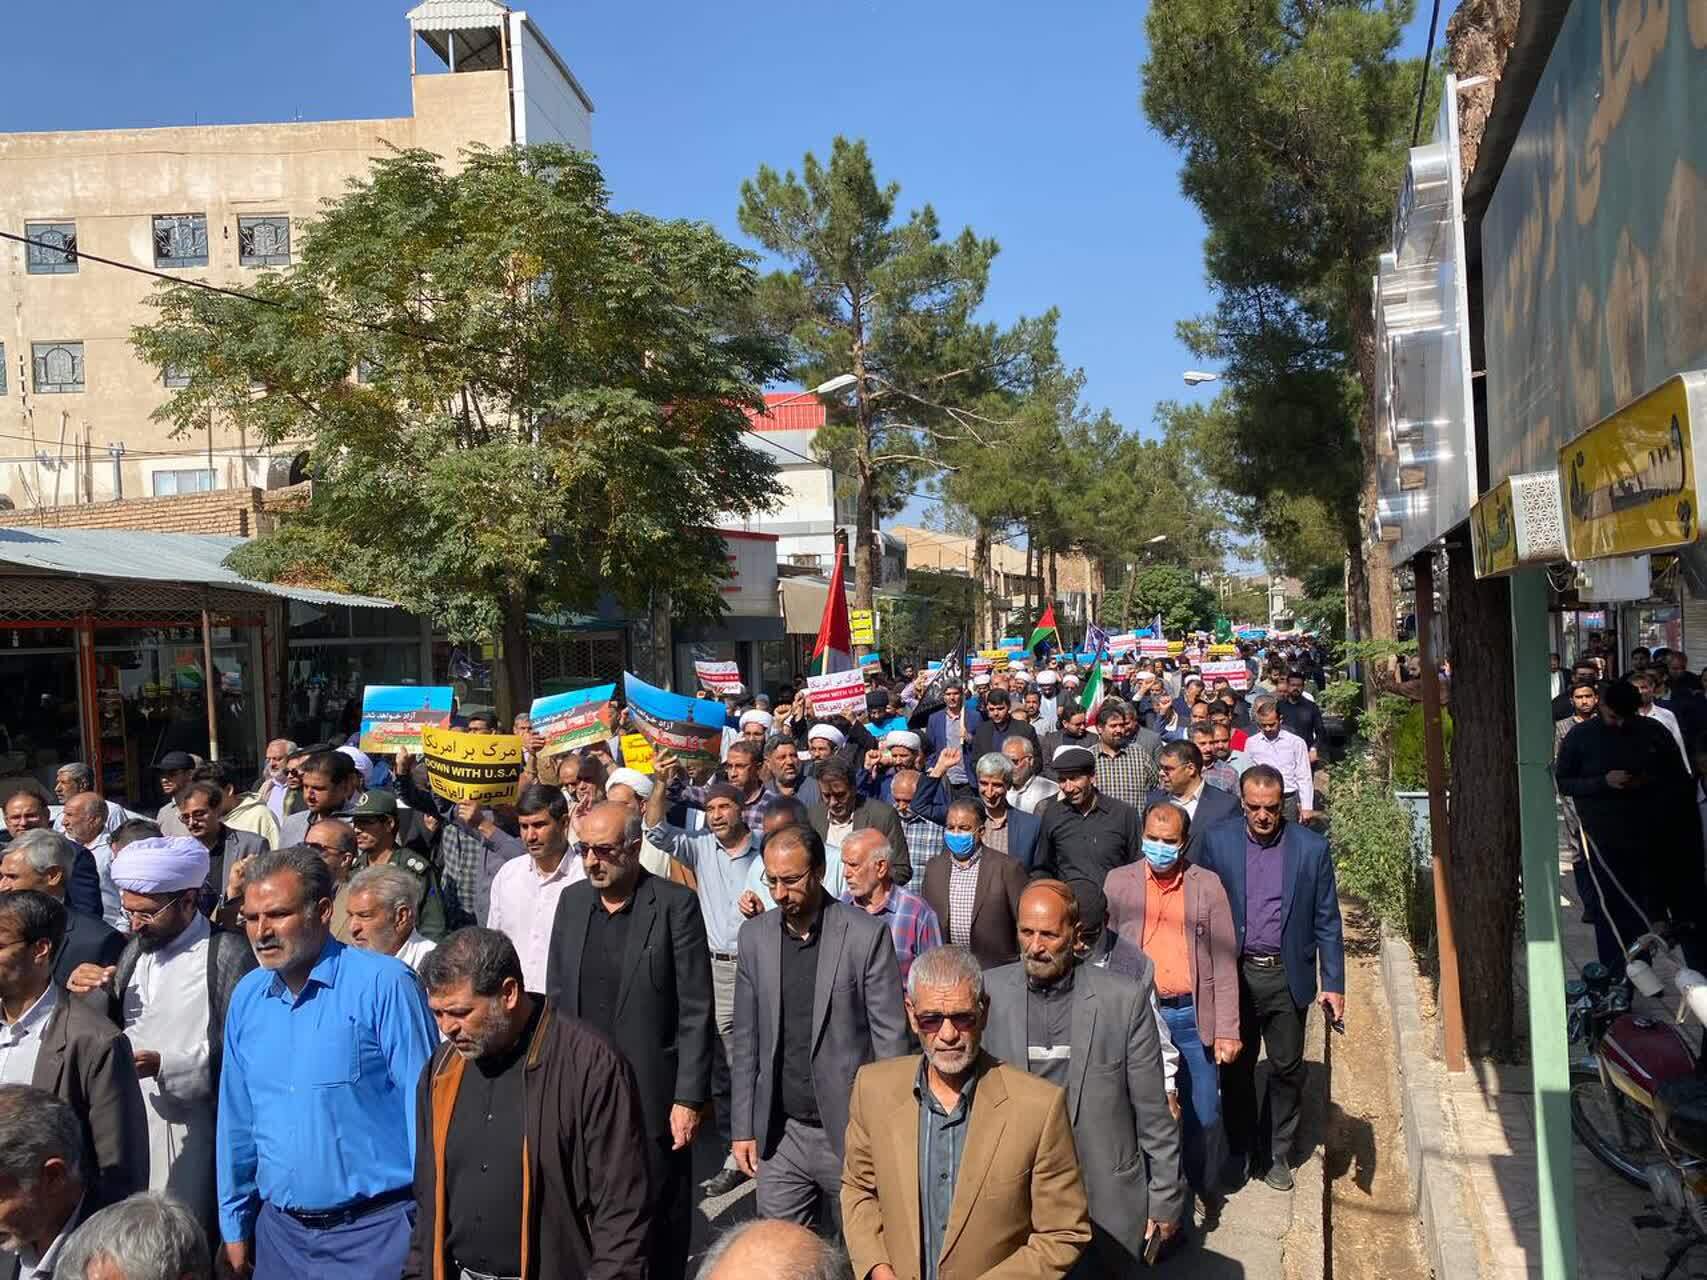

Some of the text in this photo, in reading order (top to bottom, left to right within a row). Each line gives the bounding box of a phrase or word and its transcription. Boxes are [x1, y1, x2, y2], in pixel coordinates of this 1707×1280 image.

[463, 747, 475, 760] بر
[424, 758, 450, 774] DOWN
[451, 765, 481, 778] WITH
[468, 785, 514, 803] الموت
